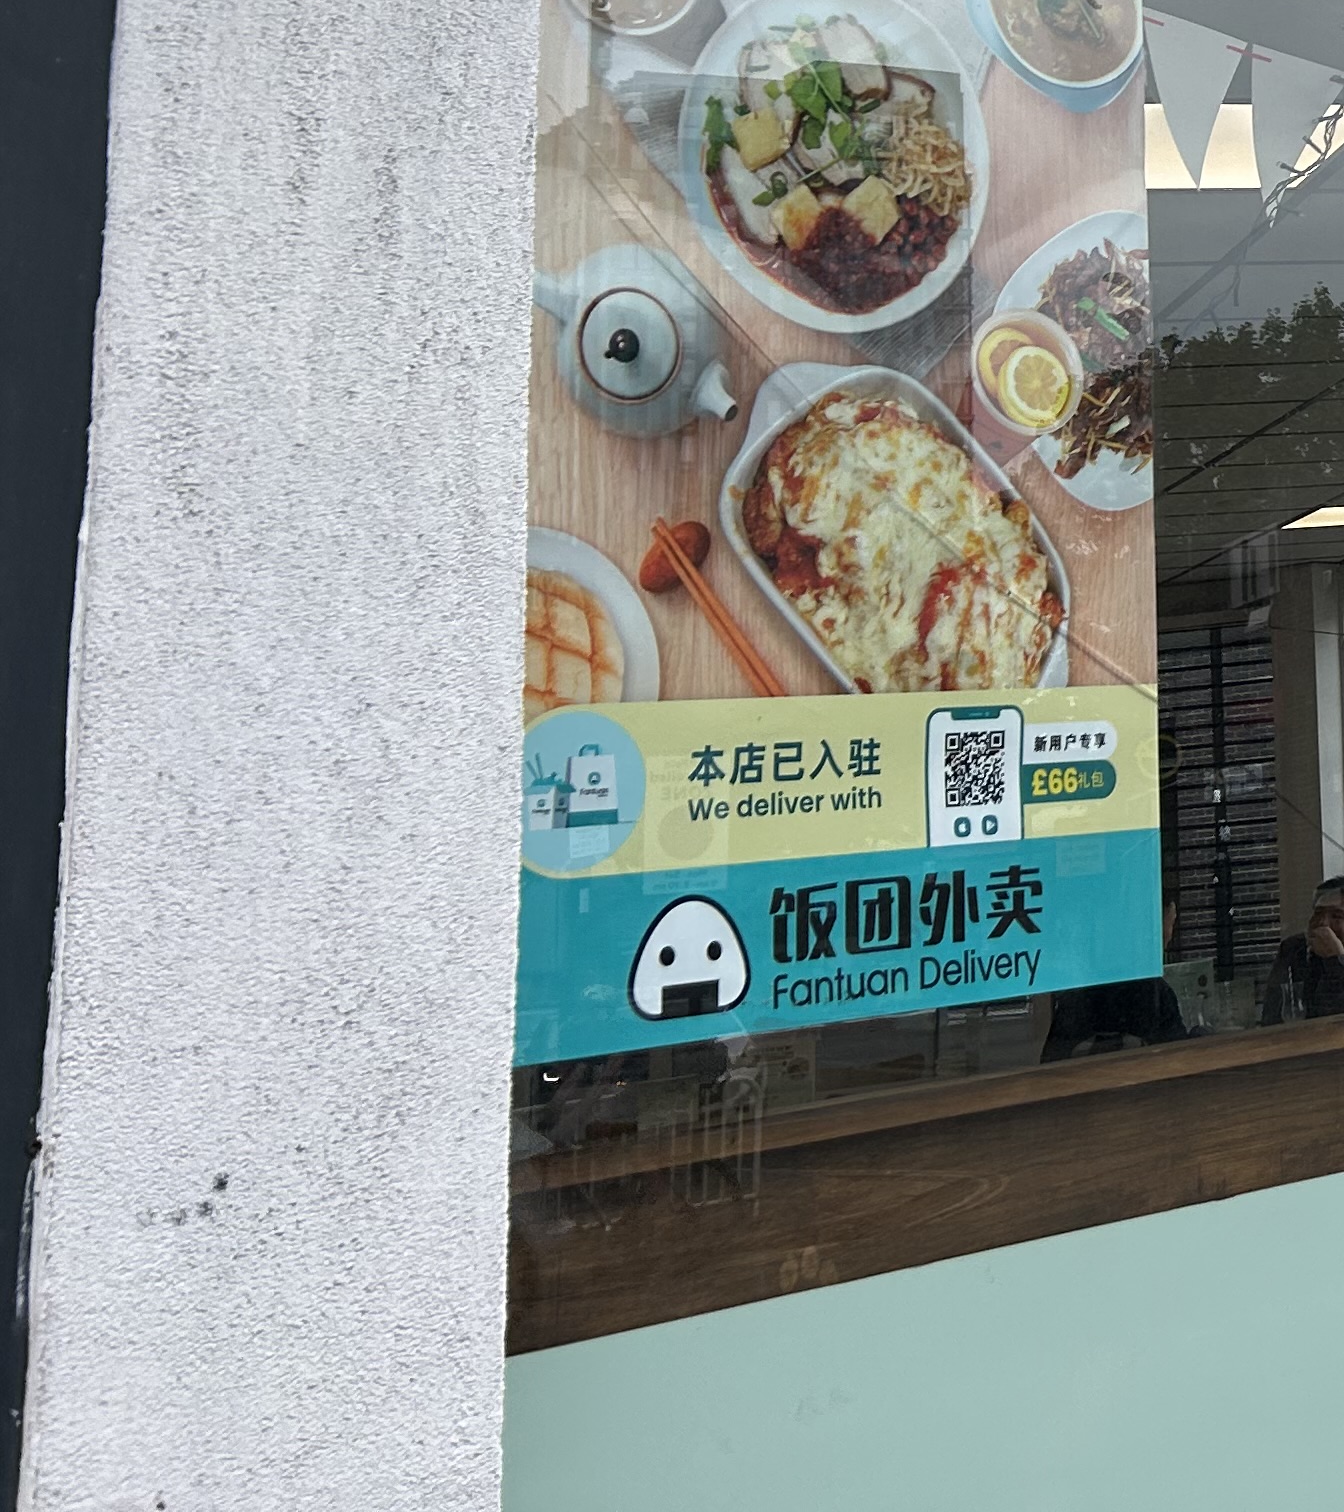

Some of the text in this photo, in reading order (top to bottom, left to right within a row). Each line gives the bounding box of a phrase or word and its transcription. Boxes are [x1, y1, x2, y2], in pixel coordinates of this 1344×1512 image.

[689, 738, 881, 787] 本店已入驻
[1033, 732, 1107, 752] 新用户专享
[688, 787, 882, 822] We deliver with
[769, 865, 1044, 964] 饭团外卖
[772, 947, 1042, 1010] Fantuan Delivery
